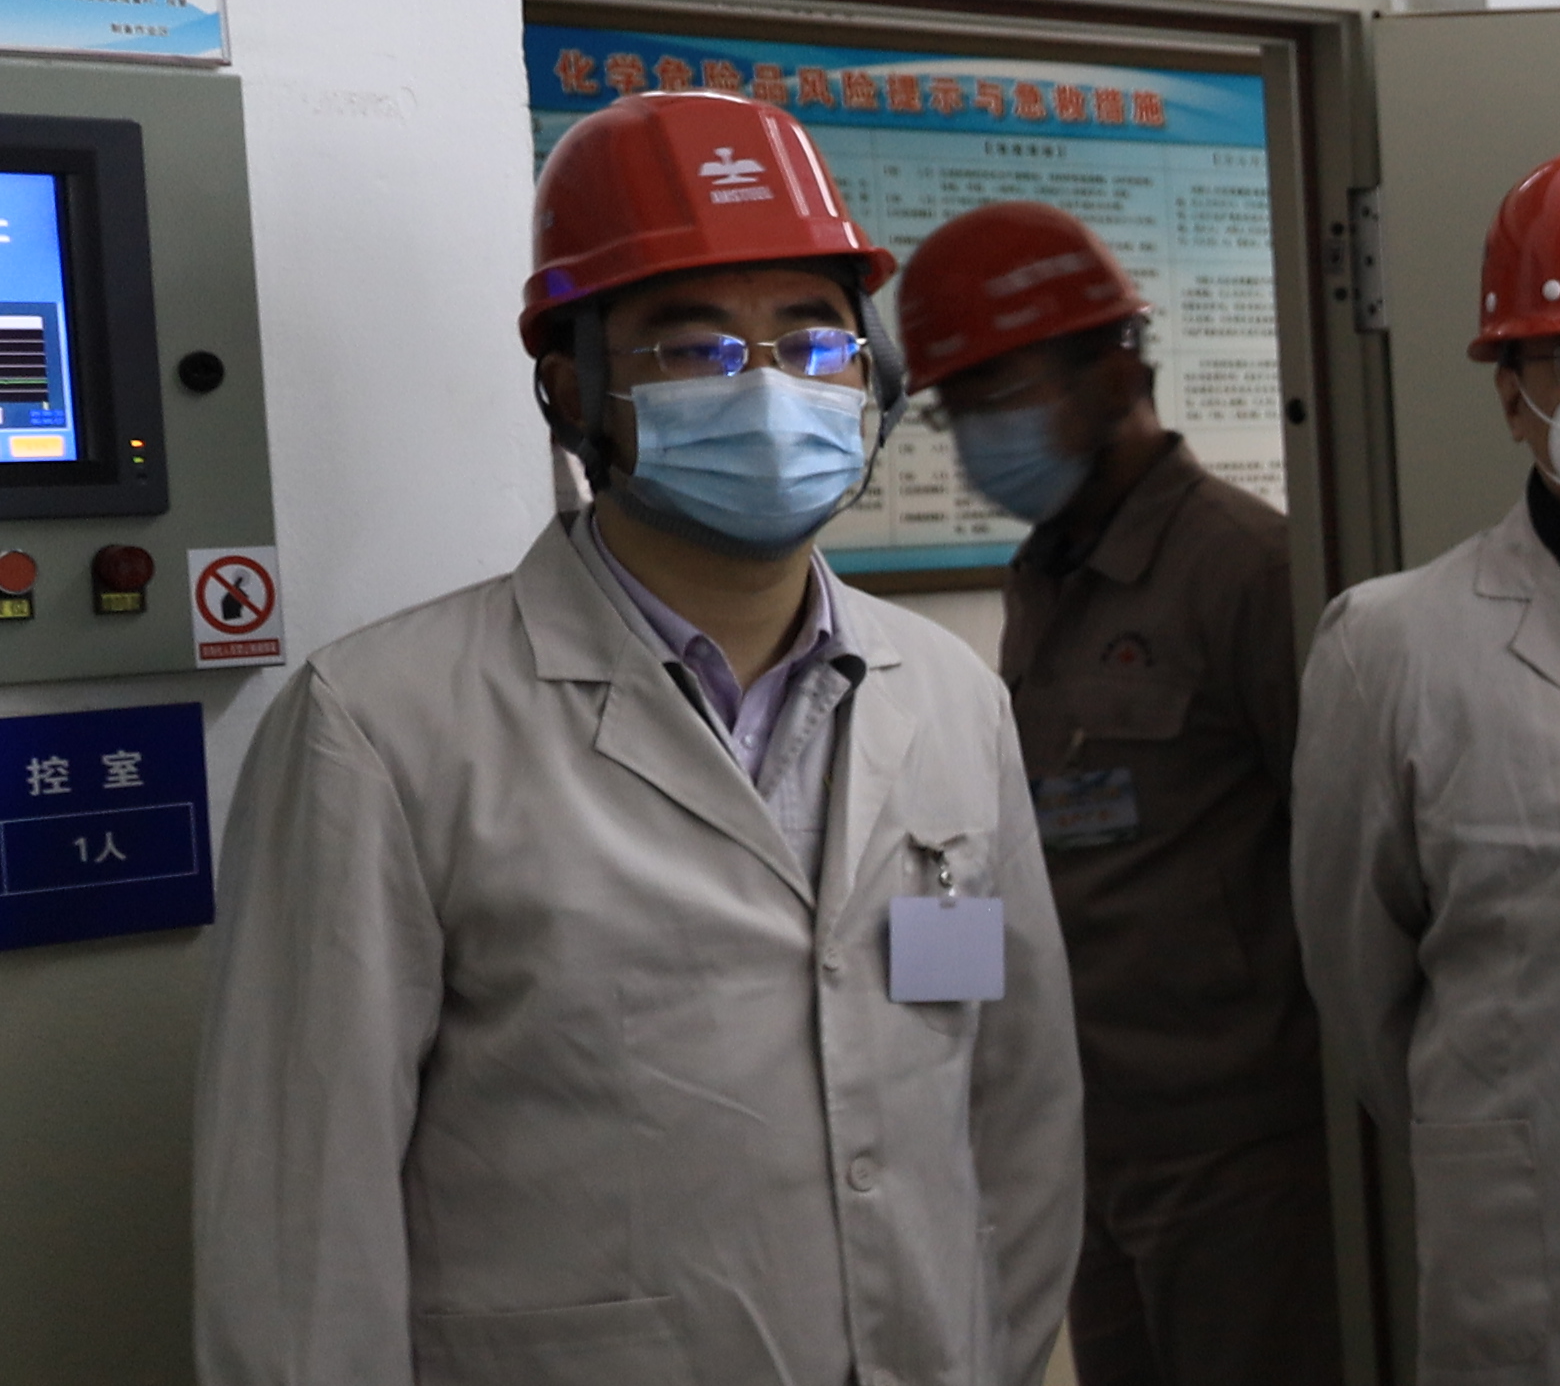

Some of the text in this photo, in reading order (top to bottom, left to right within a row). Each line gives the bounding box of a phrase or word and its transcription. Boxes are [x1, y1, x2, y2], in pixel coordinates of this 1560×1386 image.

[553, 46, 1166, 128] 化学危险品风险提示与急救措施
[26, 749, 144, 797] 控室
[74, 830, 127, 864] 1人
